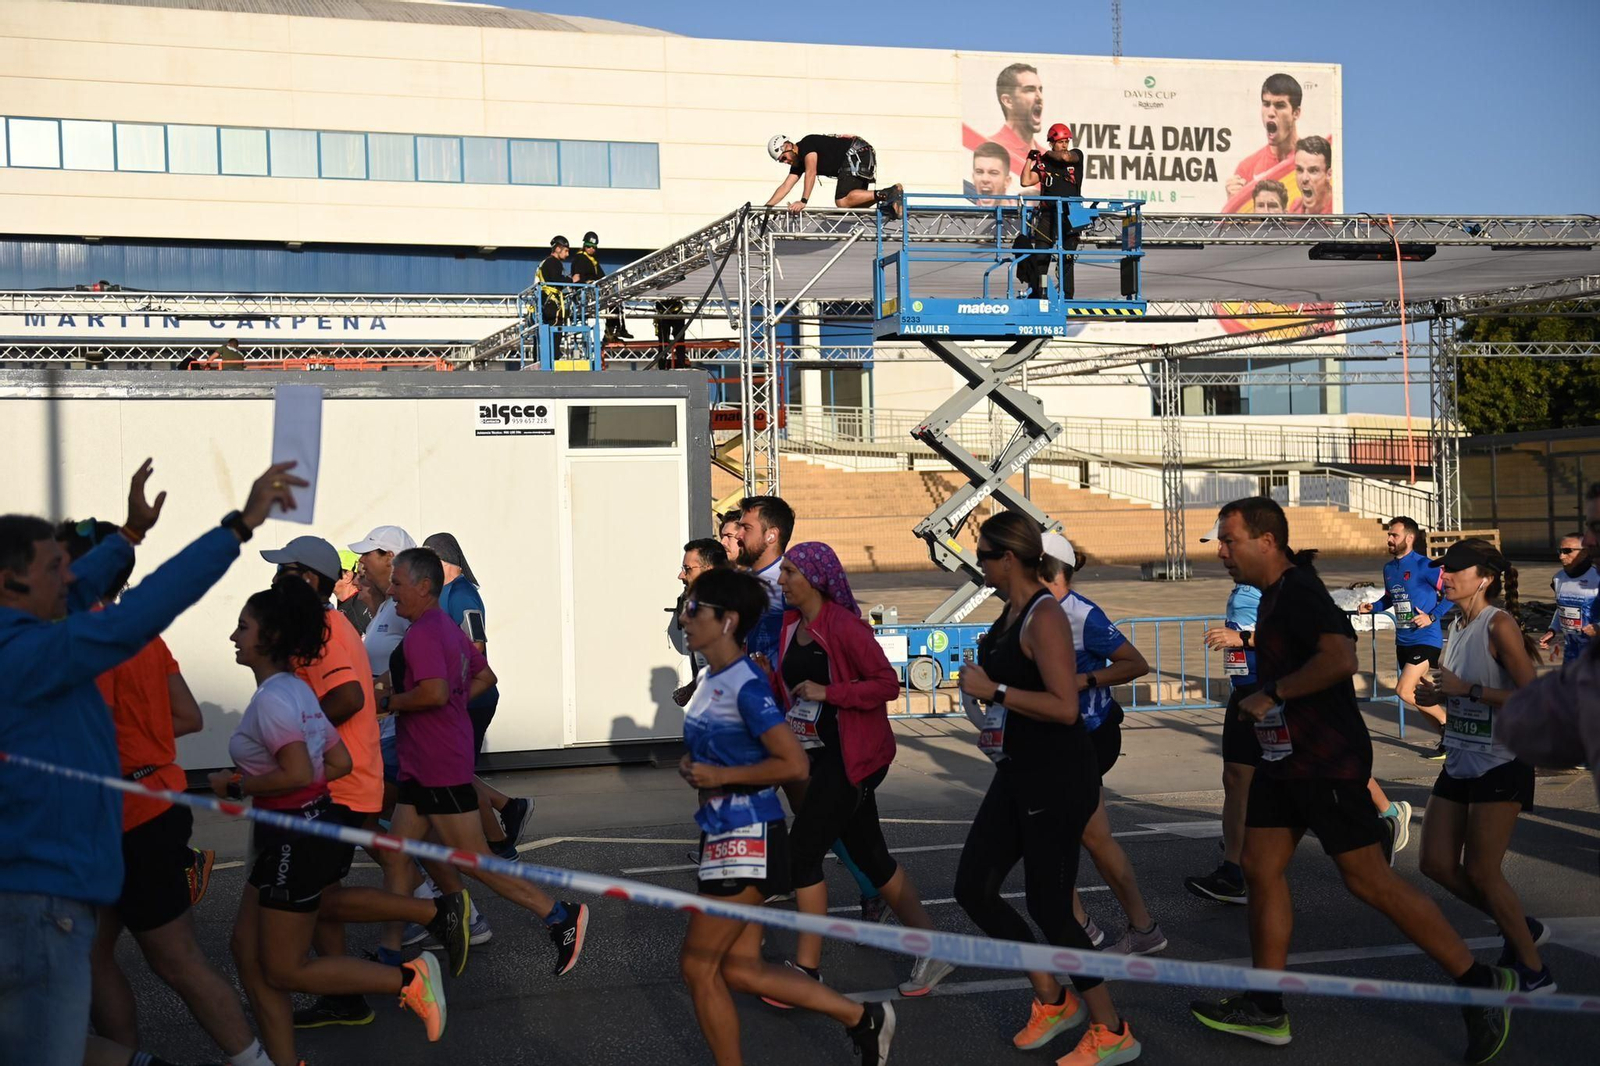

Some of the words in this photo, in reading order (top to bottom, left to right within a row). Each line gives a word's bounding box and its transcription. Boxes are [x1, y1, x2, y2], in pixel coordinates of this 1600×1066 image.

[1124, 89, 1153, 99] DAVIS
[1155, 91, 1177, 100] CUP
[1070, 123, 1121, 149] VIVE
[1128, 125, 1155, 150] LA
[1162, 126, 1232, 152] DAVIS
[1085, 154, 1115, 179] EN
[1121, 152, 1218, 182] MÁLAGA
[1128, 190, 1168, 202] FINAL
[1170, 190, 1177, 203] 8
[957, 302, 1010, 314] mateco
[901, 316, 921, 324] 5233
[903, 325, 950, 335] ALQUILER
[1018, 326, 1033, 335] 902
[1034, 326, 1042, 335] 11
[1043, 326, 1053, 335] 96
[1053, 326, 1064, 335] 82
[479, 404, 547, 425] algeco
[715, 412, 765, 421] mato
[1010, 437, 1048, 473] ALQUILER
[949, 485, 991, 525] mateco
[714, 840, 747, 858] 5656
[276, 843, 292, 886] WONG
